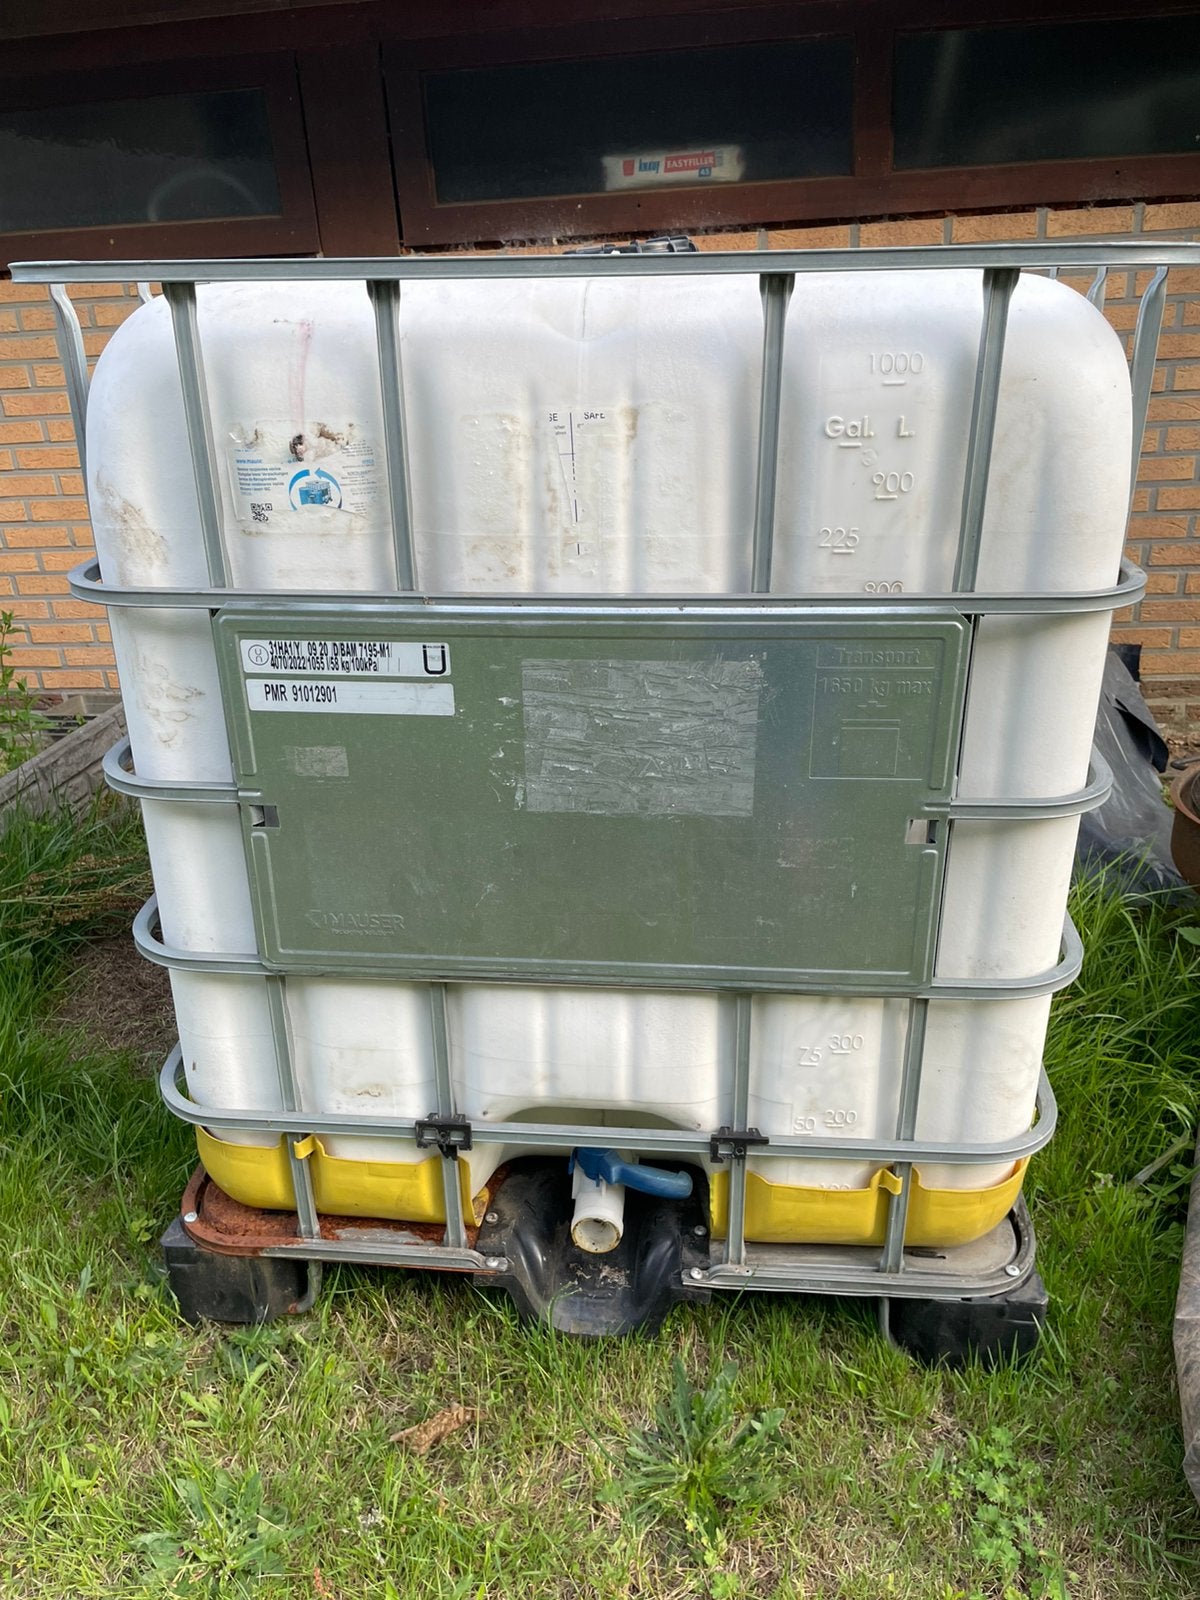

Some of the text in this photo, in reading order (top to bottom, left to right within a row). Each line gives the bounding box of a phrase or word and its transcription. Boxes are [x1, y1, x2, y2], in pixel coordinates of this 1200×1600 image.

[666, 157, 714, 169] EASYFILLER
[869, 352, 924, 375] 1000
[824, 416, 875, 439] Gal.
[872, 472, 914, 493] 900
[818, 527, 860, 548] 225
[307, 641, 317, 656] 09
[319, 641, 329, 656] 20
[835, 647, 920, 668] Transport
[264, 683, 337, 703] PMR 91012901
[896, 680, 931, 694] max
[329, 912, 405, 929] MAUSER
[829, 1034, 864, 1050] 300
[800, 1047, 822, 1063] 75
[795, 1117, 816, 1130] 50
[824, 1110, 857, 1124] 200
